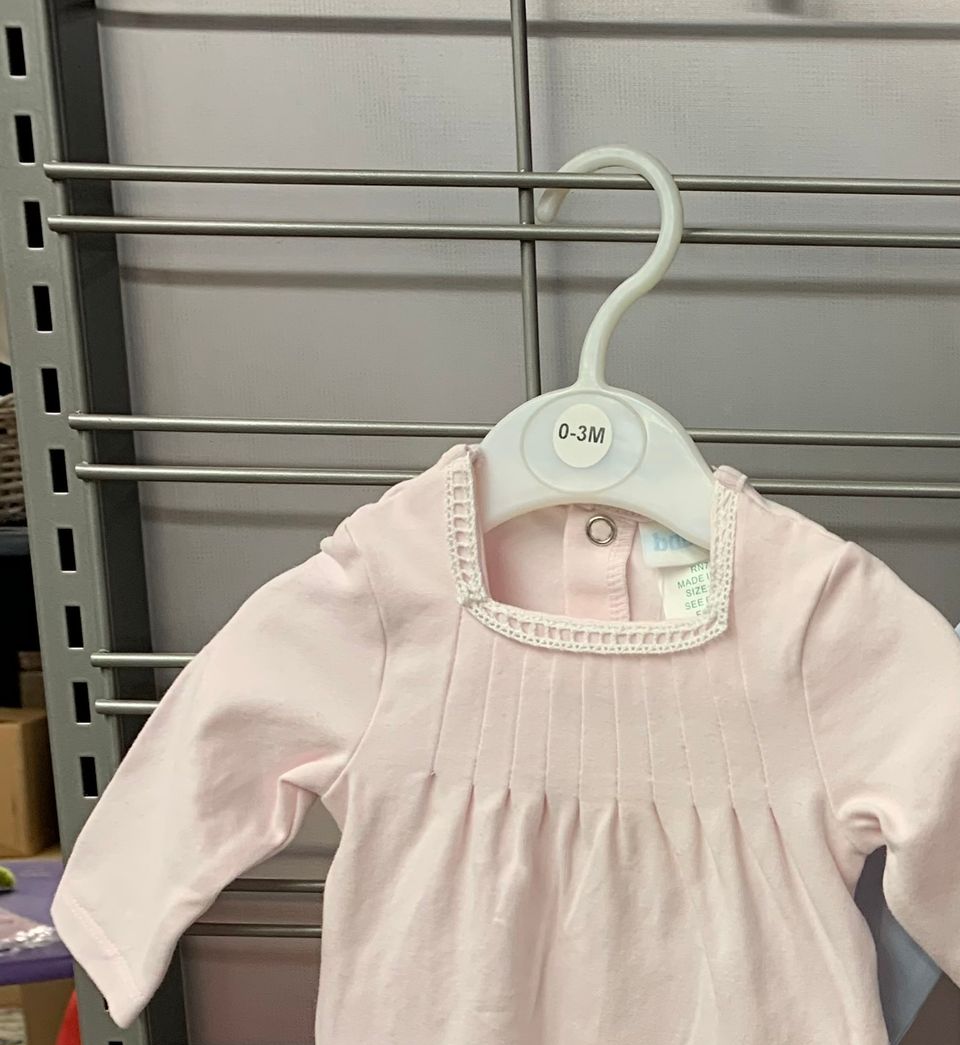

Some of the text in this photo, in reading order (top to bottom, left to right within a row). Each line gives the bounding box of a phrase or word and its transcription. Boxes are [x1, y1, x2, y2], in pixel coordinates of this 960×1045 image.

[558, 422, 606, 444] 0-3M
[677, 574, 705, 589] MADE
[684, 597, 705, 610] SEE
